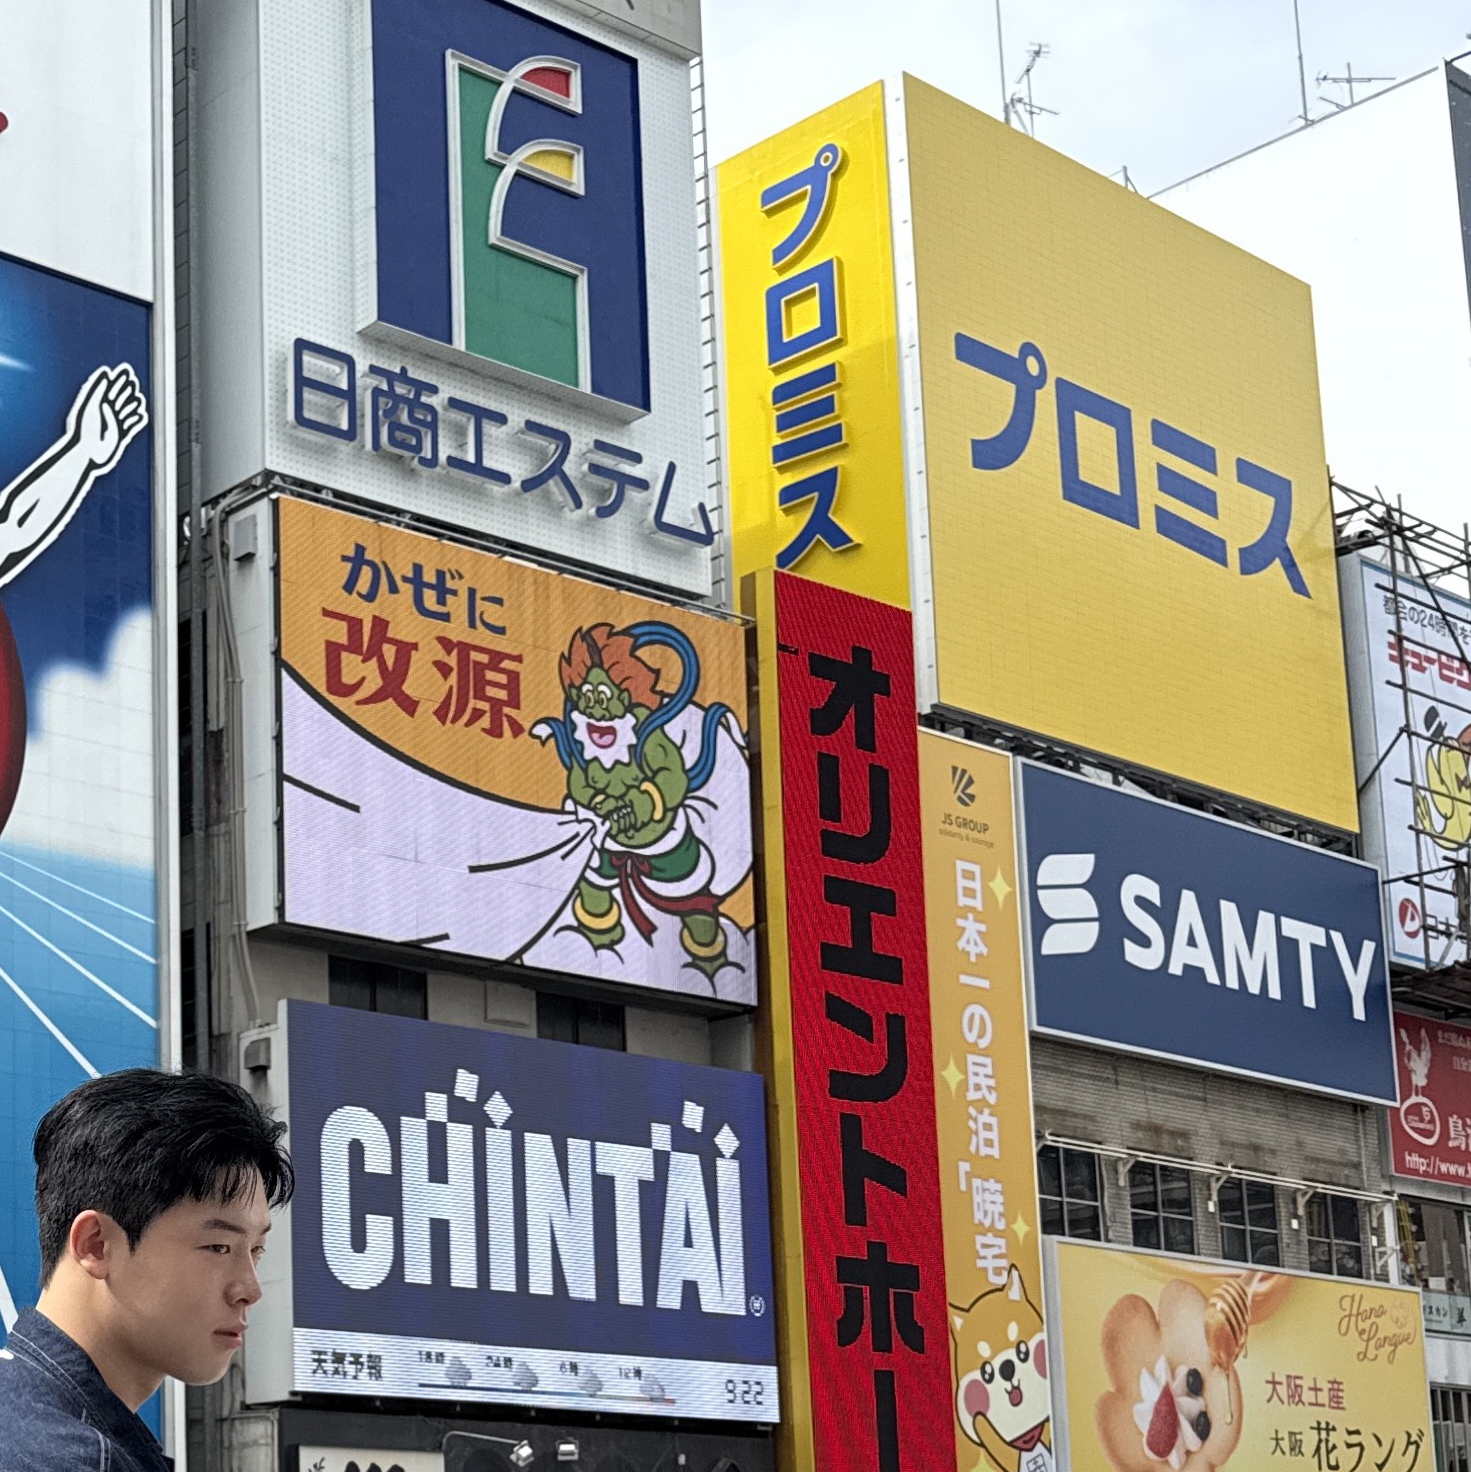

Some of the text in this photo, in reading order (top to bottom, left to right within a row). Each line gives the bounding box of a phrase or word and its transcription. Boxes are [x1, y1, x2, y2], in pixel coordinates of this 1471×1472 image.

[759, 142, 861, 570] プロミス
[292, 337, 715, 546] 日商エステム
[954, 332, 1312, 600] プロミス
[340, 542, 508, 636] かぜに
[321, 607, 526, 740] 改源
[941, 812, 990, 835] JS GROUP
[1119, 873, 1377, 1022] SAMTY
[320, 1069, 747, 1316] CHINTAI
[1338, 1293, 1387, 1337] Hana
[1356, 1321, 1417, 1365] Langue
[310, 1349, 383, 1381] 天気予報
[1265, 1371, 1347, 1412] 大阪土産
[1269, 1428, 1305, 1458] 大阪
